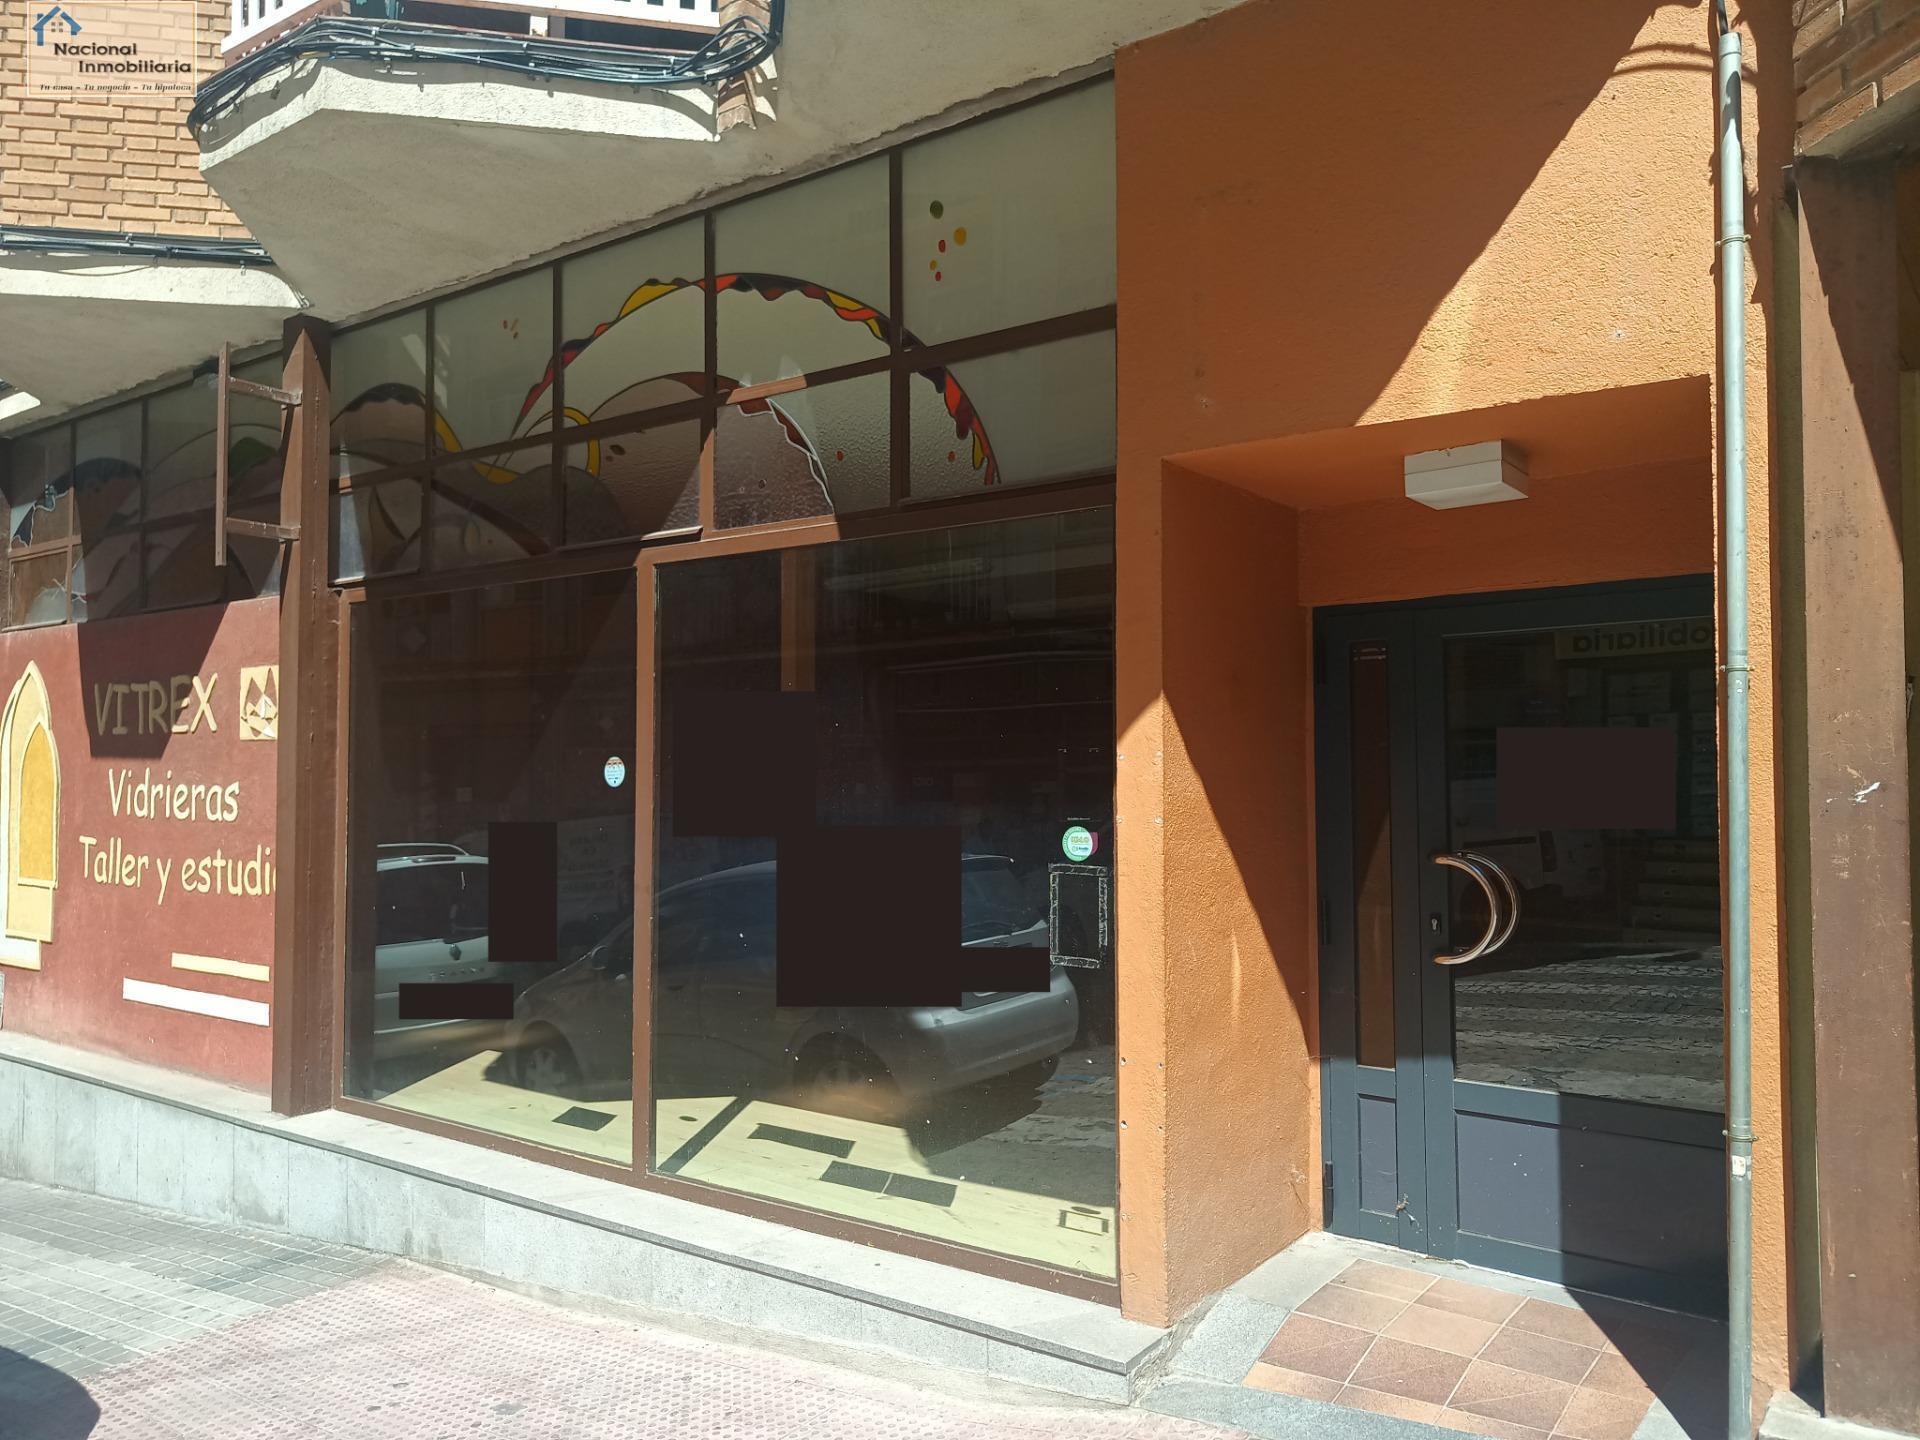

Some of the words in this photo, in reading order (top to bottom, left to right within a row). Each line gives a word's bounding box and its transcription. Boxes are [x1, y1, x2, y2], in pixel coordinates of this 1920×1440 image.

[93, 672, 219, 737] VITREX
[107, 767, 241, 823] Vidrieras
[78, 834, 150, 889] Taller
[155, 857, 172, 906] y
[180, 843, 277, 897] estudi
